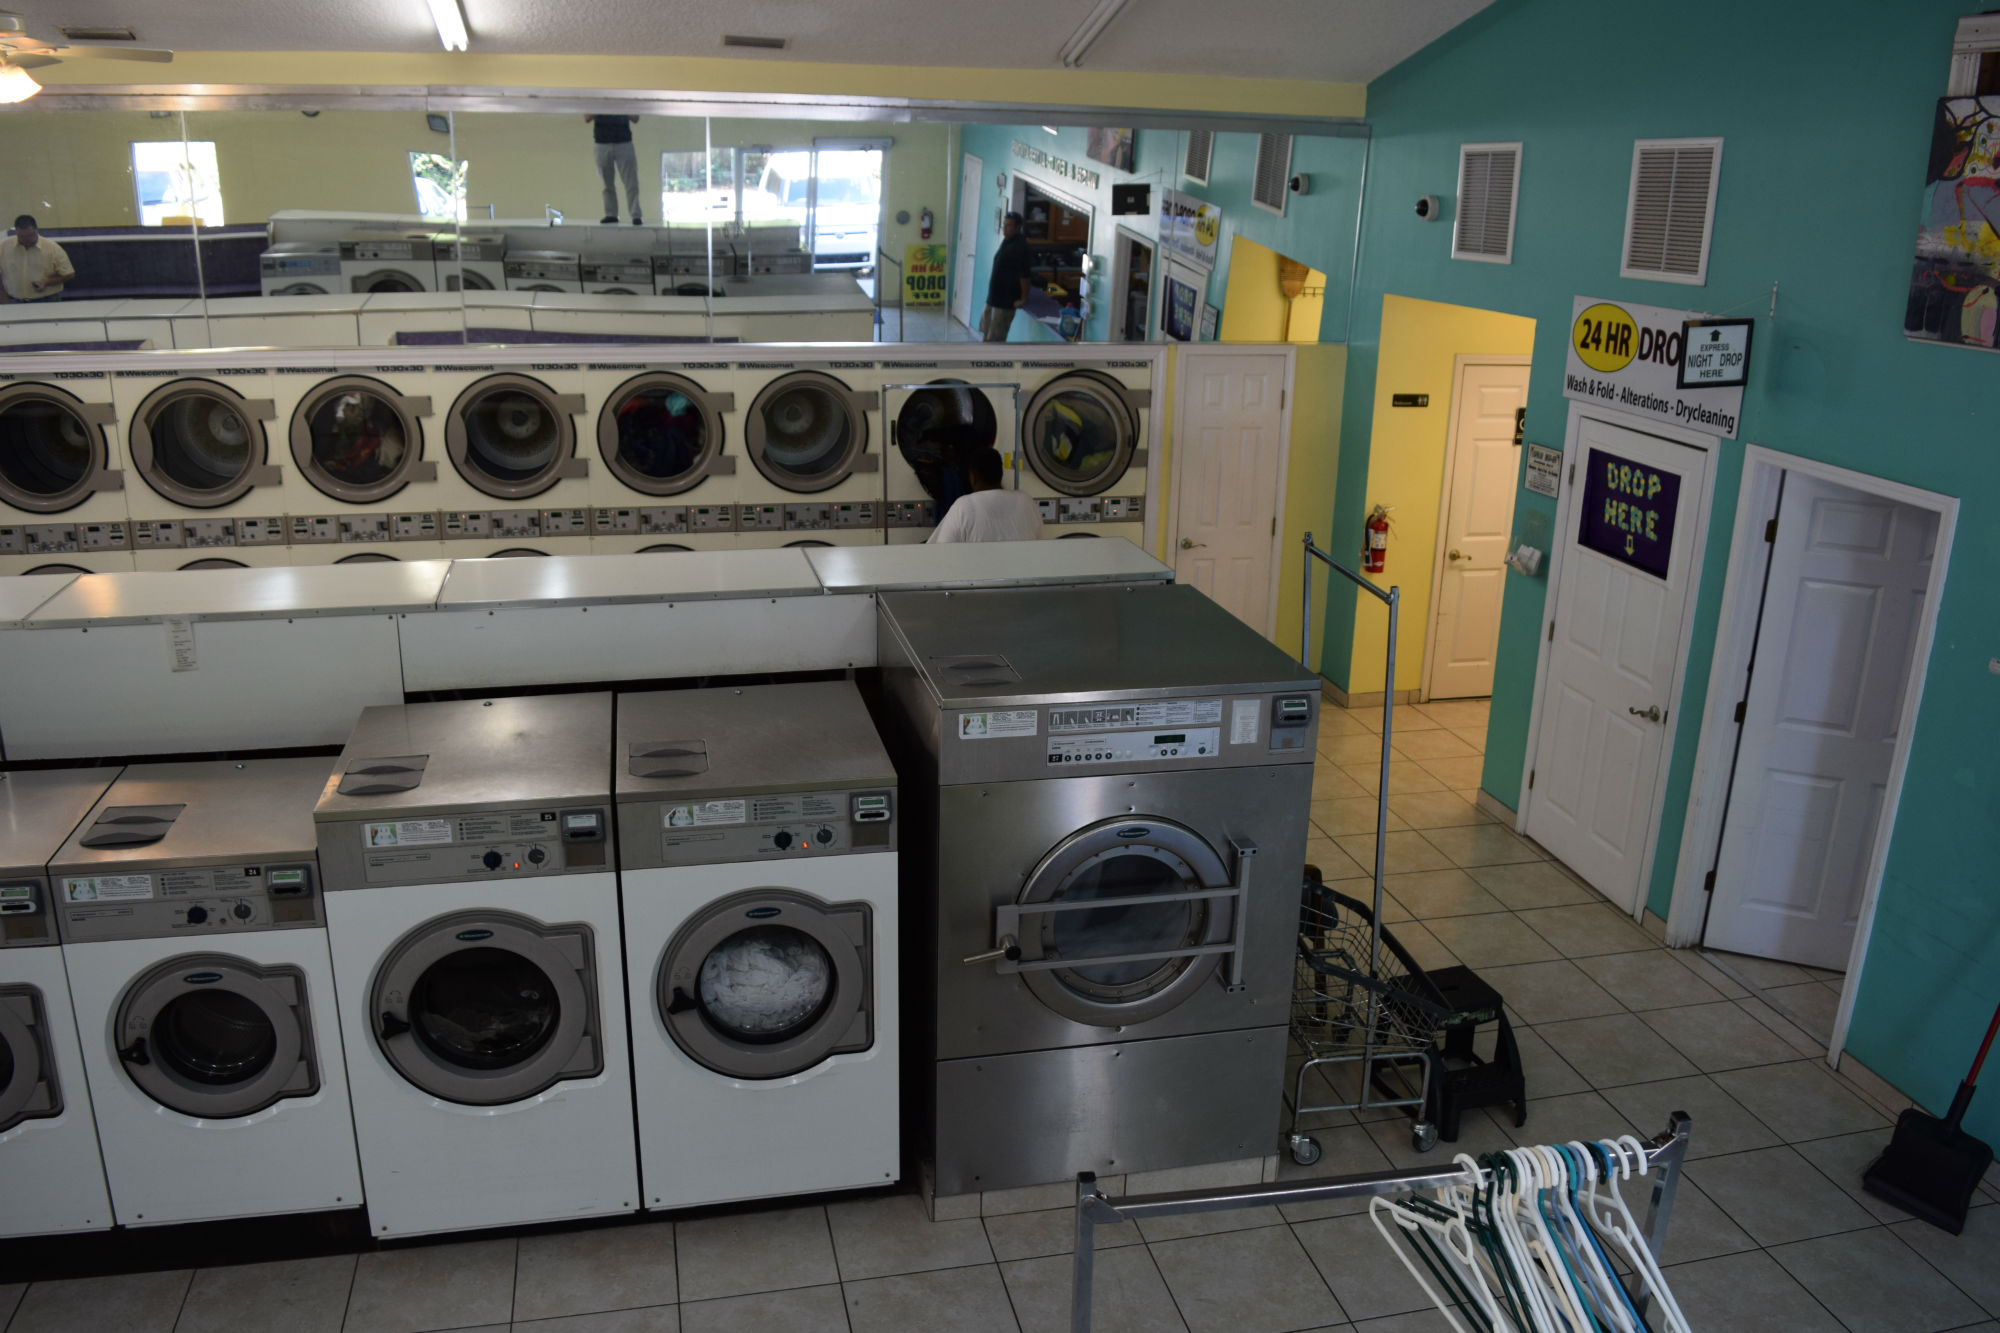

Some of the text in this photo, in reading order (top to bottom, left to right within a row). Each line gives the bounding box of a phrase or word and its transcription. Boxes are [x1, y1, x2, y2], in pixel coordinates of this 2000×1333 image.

[1580, 318, 1602, 351] 24
[1605, 321, 1632, 358] HR
[1700, 343, 1729, 352] EXPRESS
[125, 369, 179, 377] Wascomat
[1688, 352, 1743, 368] NIGHT DROP
[1699, 369, 1724, 378] HERE
[1567, 374, 1587, 393] Wash
[1588, 379, 1595, 395] &
[1596, 381, 1615, 400] Fold
[1620, 386, 1669, 414] Alterations
[1675, 399, 1735, 434] Drycleaning
[1608, 462, 1661, 500] DROP
[1604, 497, 1659, 542] HERE
